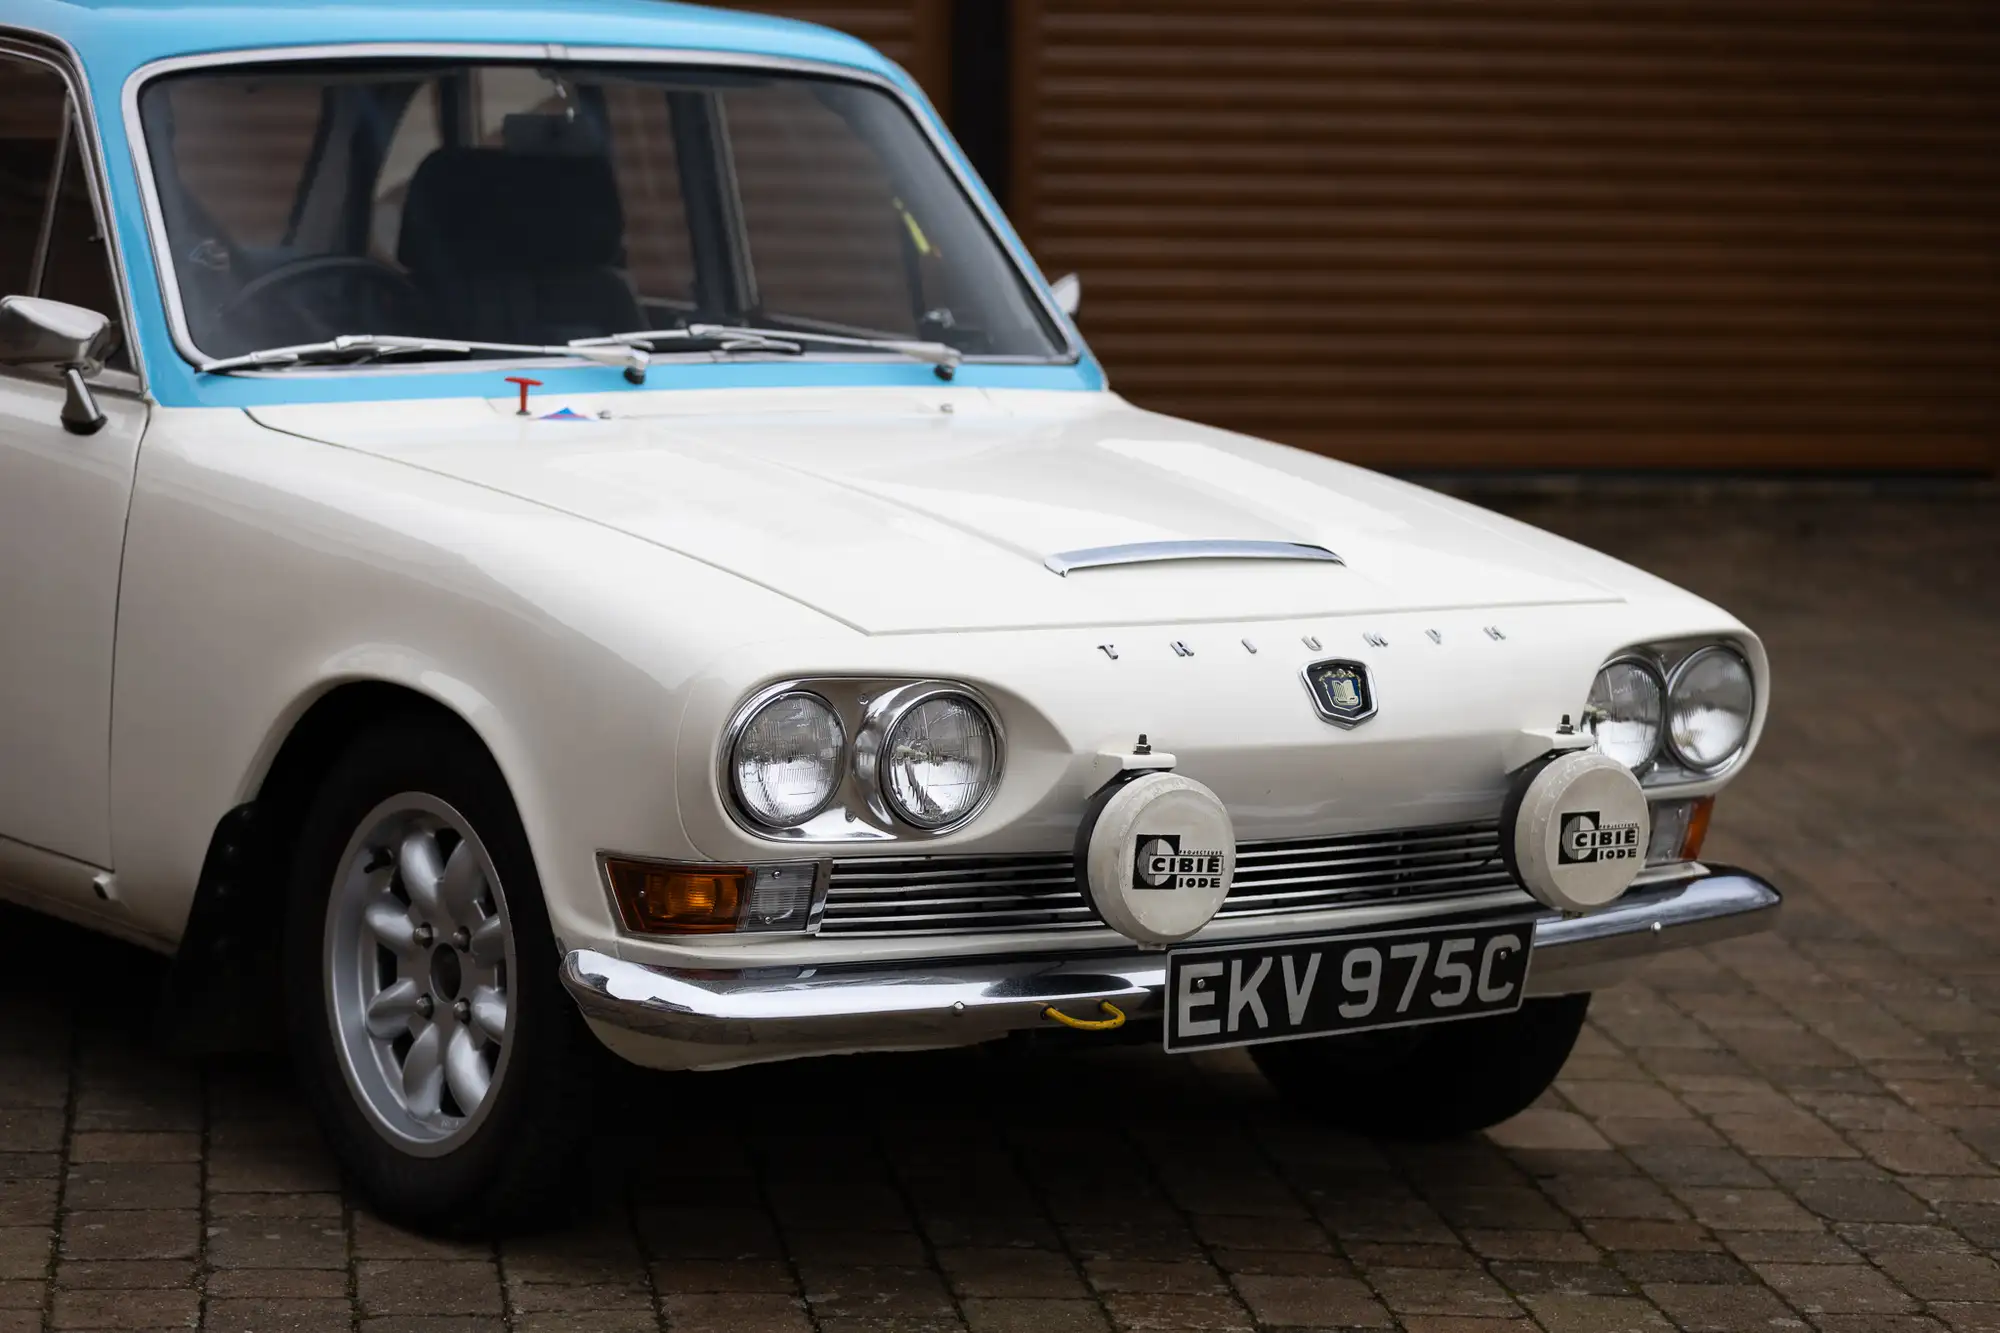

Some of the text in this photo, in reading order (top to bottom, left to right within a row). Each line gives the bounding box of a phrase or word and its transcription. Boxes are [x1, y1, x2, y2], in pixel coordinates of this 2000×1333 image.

[1097, 625, 1507, 660] TRIUMPH
[1600, 848, 1637, 860] IODE
[1179, 877, 1221, 888] IODE
[1178, 933, 1521, 1038] EKV 975C
